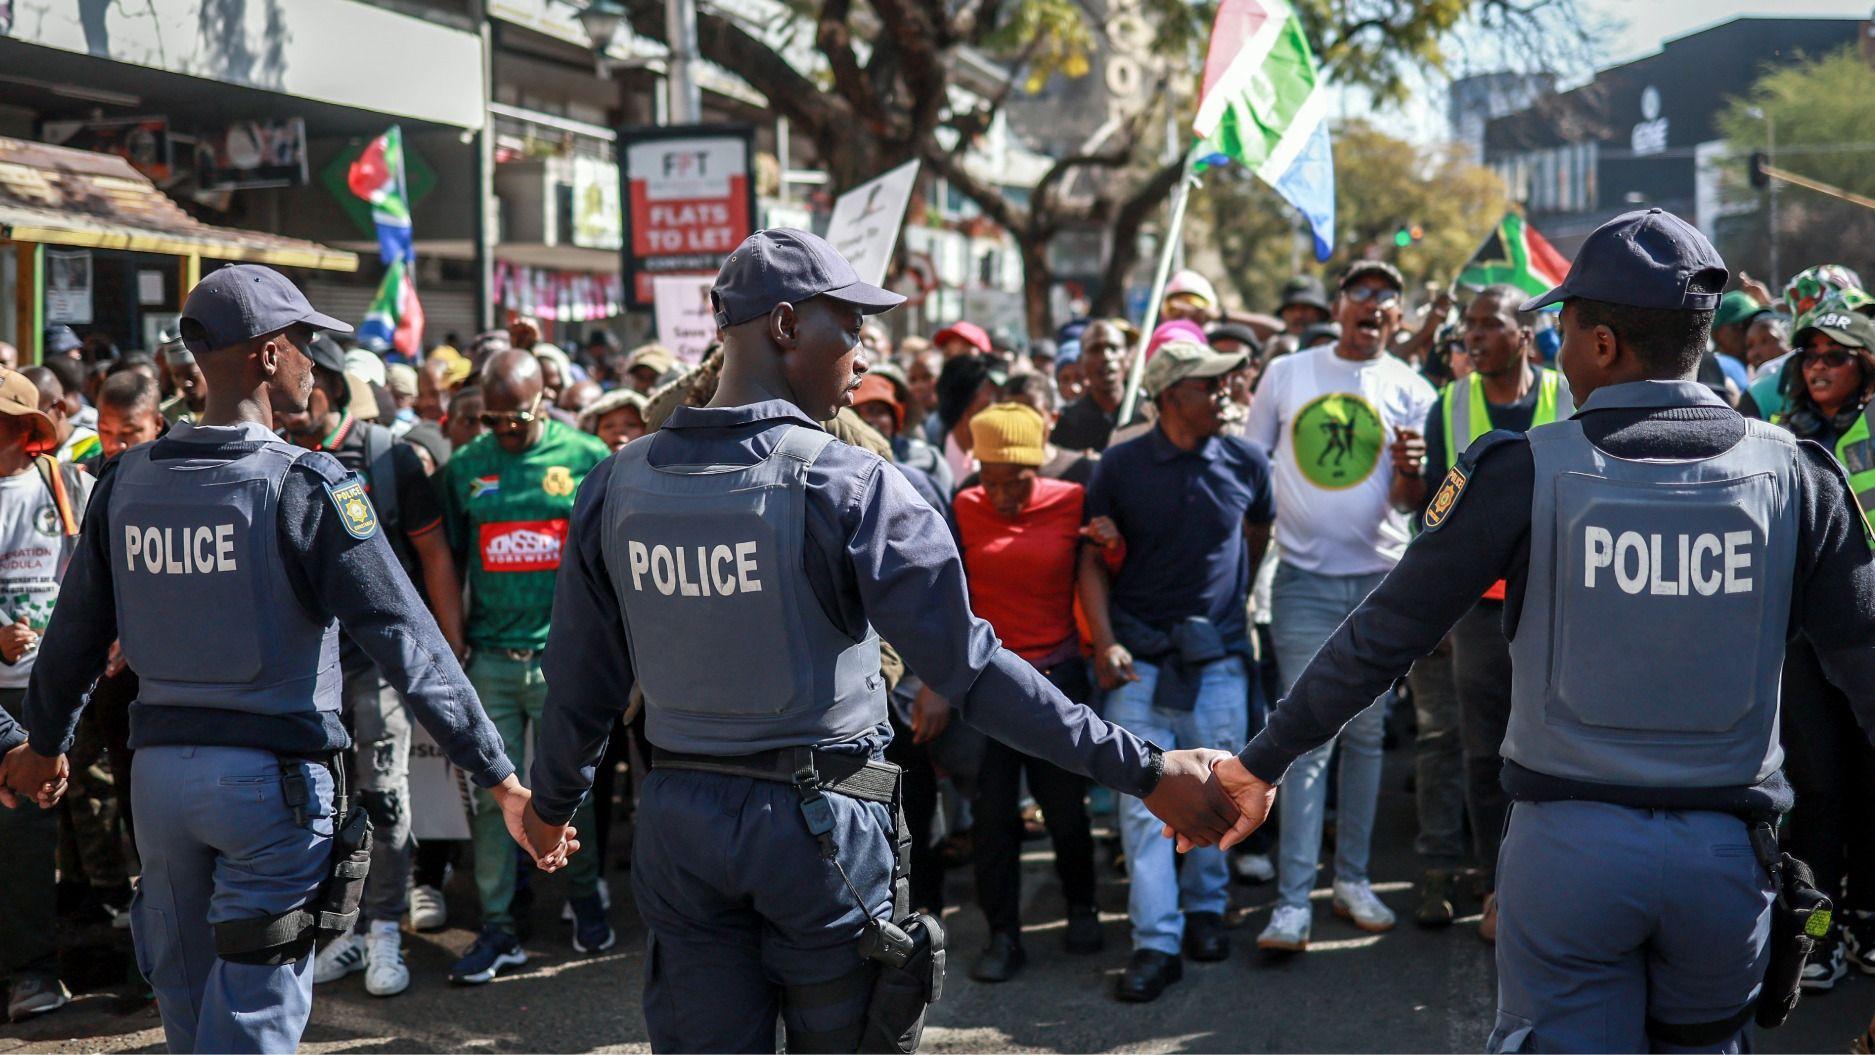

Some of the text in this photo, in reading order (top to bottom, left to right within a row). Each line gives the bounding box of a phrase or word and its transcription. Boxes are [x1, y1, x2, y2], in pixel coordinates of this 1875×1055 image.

[650, 204, 728, 226] FLATS
[647, 227, 733, 251] TO LET
[1448, 468, 1465, 490] POLICE
[336, 485, 363, 502] POLICE
[125, 524, 237, 575] POLICE
[1584, 525, 1753, 597] POLICE
[628, 540, 762, 597] POLICE
